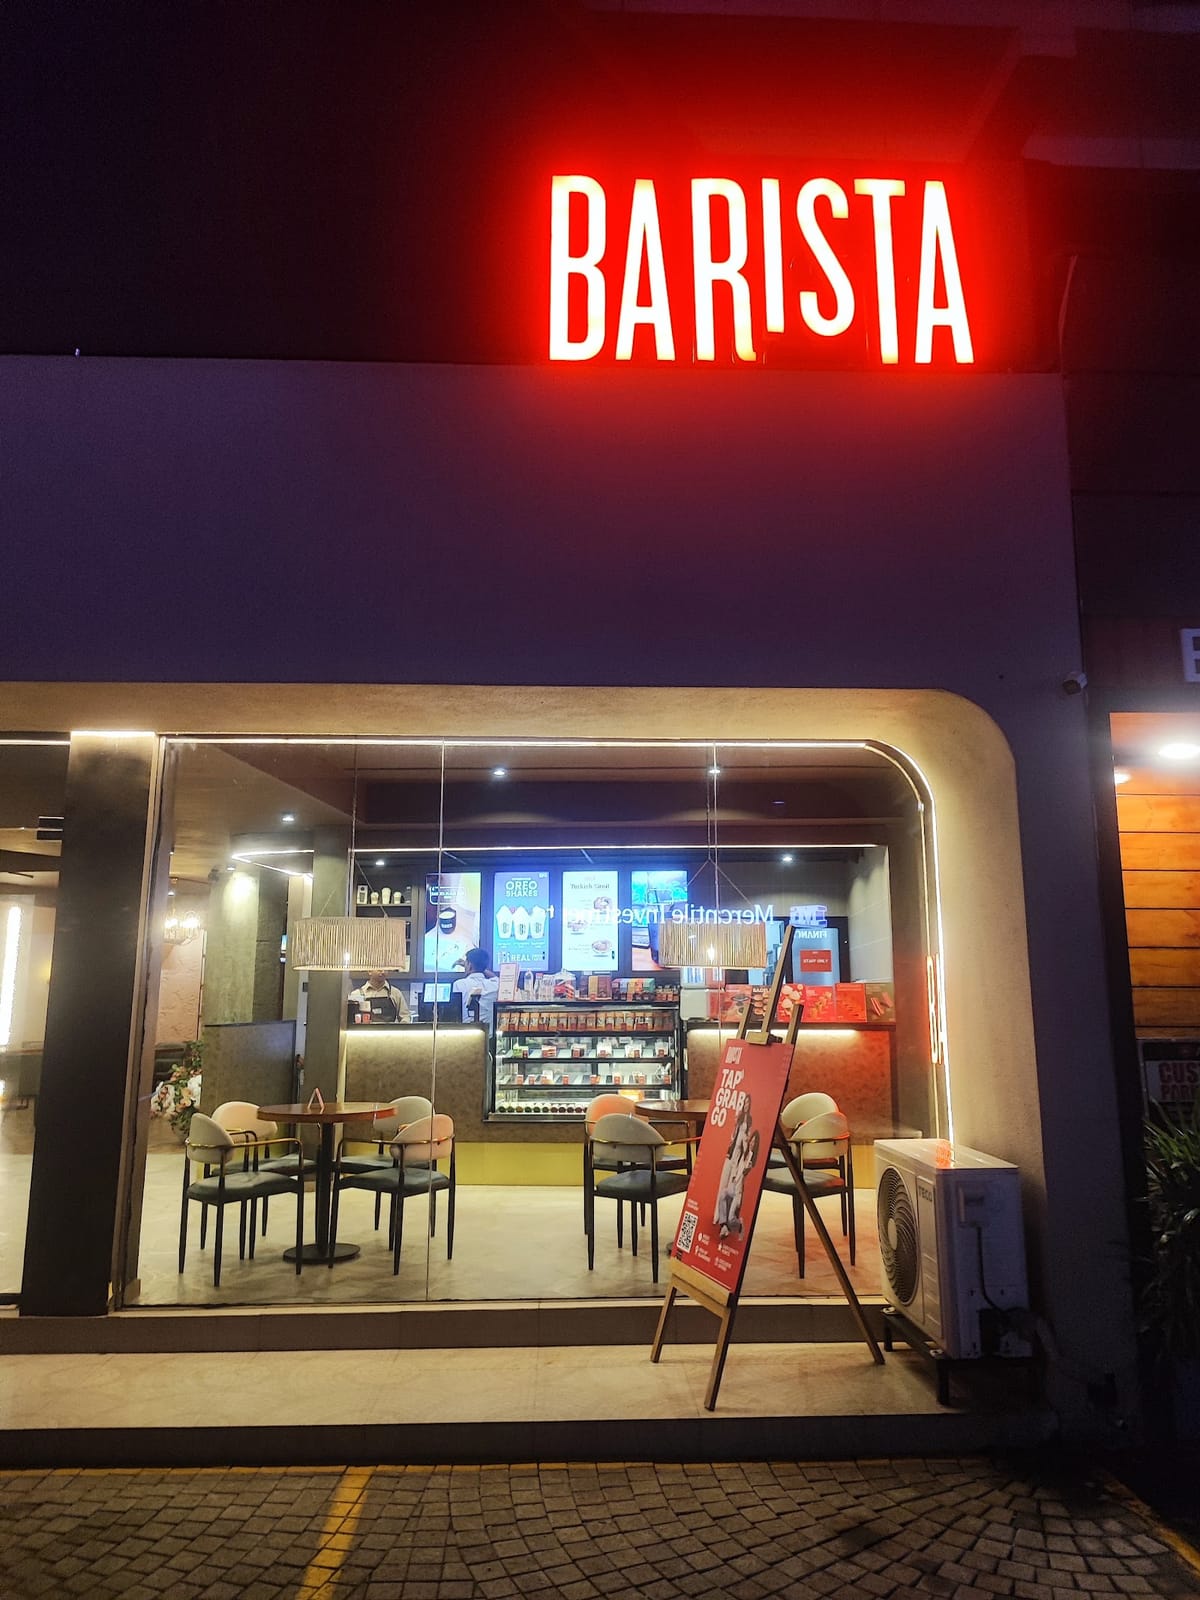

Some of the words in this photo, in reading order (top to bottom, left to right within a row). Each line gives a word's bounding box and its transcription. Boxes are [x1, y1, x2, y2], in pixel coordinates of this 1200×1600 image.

[549, 175, 974, 364] BARISTA
[505, 881, 537, 890] OREO
[715, 1088, 746, 1113] GRAB
[711, 1106, 727, 1127] GO
